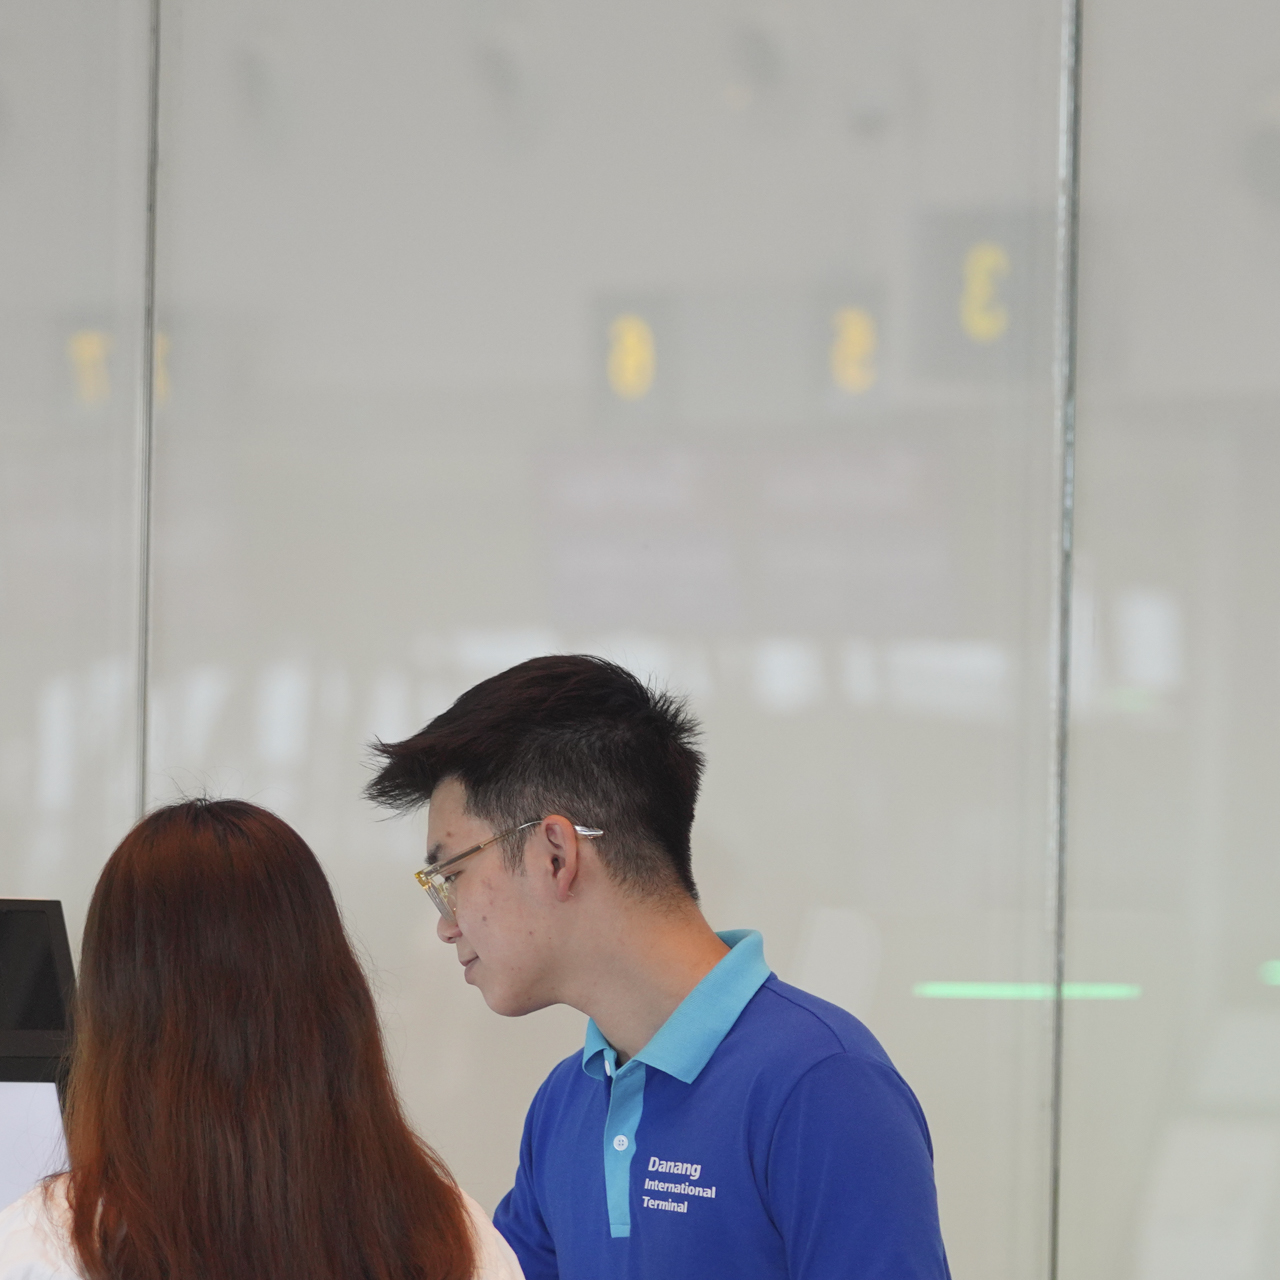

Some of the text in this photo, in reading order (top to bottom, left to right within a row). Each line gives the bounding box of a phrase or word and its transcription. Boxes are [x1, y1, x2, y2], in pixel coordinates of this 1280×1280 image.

[648, 1156, 701, 1180] Danang
[644, 1178, 716, 1198] International
[642, 1196, 688, 1213] Terminal
